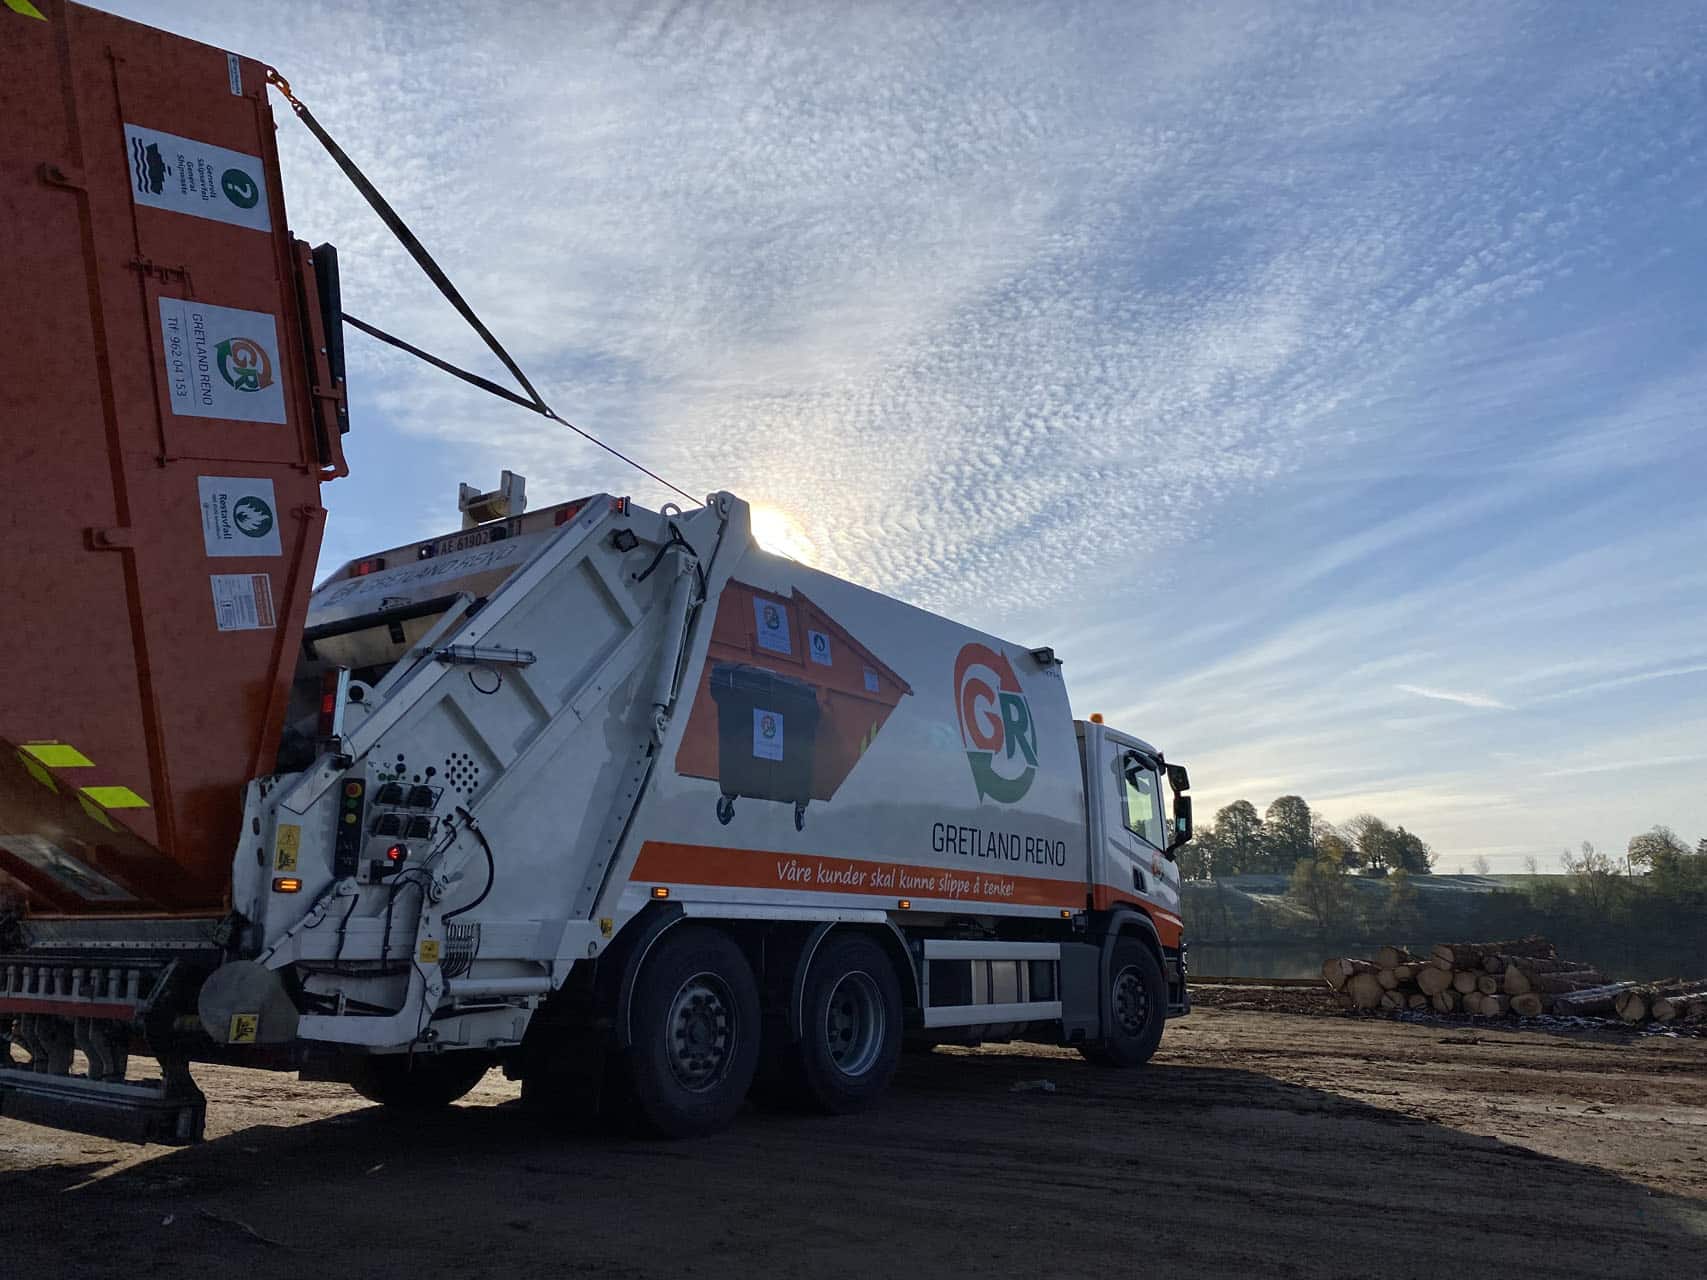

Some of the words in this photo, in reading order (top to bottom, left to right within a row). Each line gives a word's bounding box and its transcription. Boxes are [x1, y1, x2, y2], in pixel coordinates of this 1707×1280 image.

[176, 153, 187, 196] Shipwaste
[186, 160, 197, 193] General
[170, 336, 183, 357] 962
[192, 313, 209, 375] GRETLAND
[173, 357, 185, 374] 04
[175, 378, 188, 398] 153
[200, 375, 213, 406] RENO
[218, 493, 232, 540] Restavfall
[932, 822, 1021, 861] GRETLAND
[1025, 836, 1066, 867] RENO
[777, 856, 812, 881] Våre
[816, 863, 866, 886] kunder
[870, 868, 896, 888] skal
[899, 869, 935, 891] kunne
[939, 872, 970, 898] slippe
[973, 876, 980, 894] å
[984, 879, 1015, 897] tenke!
